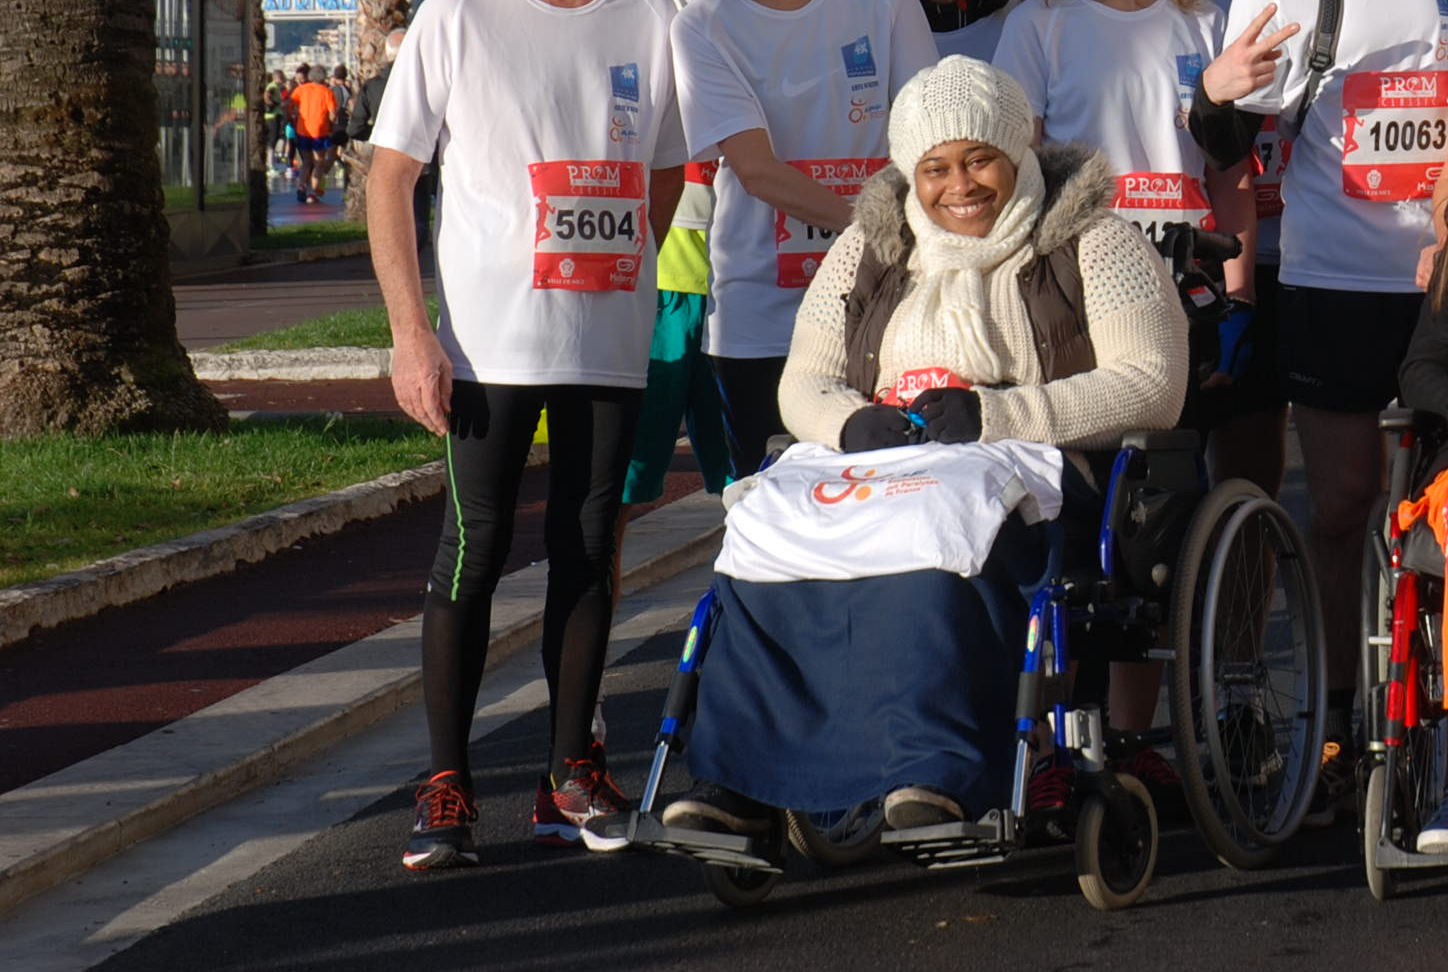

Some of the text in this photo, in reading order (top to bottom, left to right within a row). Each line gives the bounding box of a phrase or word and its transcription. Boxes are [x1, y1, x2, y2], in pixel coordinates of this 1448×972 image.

[1380, 76, 1437, 94] PROM
[1381, 97, 1437, 107] CLASSIC
[1370, 119, 1447, 151] 10063
[567, 164, 621, 183] PROM
[810, 163, 868, 181] PROM
[1125, 177, 1183, 195] PROM
[1124, 198, 1184, 208] CLASSIC
[555, 209, 635, 241] 5604
[896, 373, 950, 395] PROM
